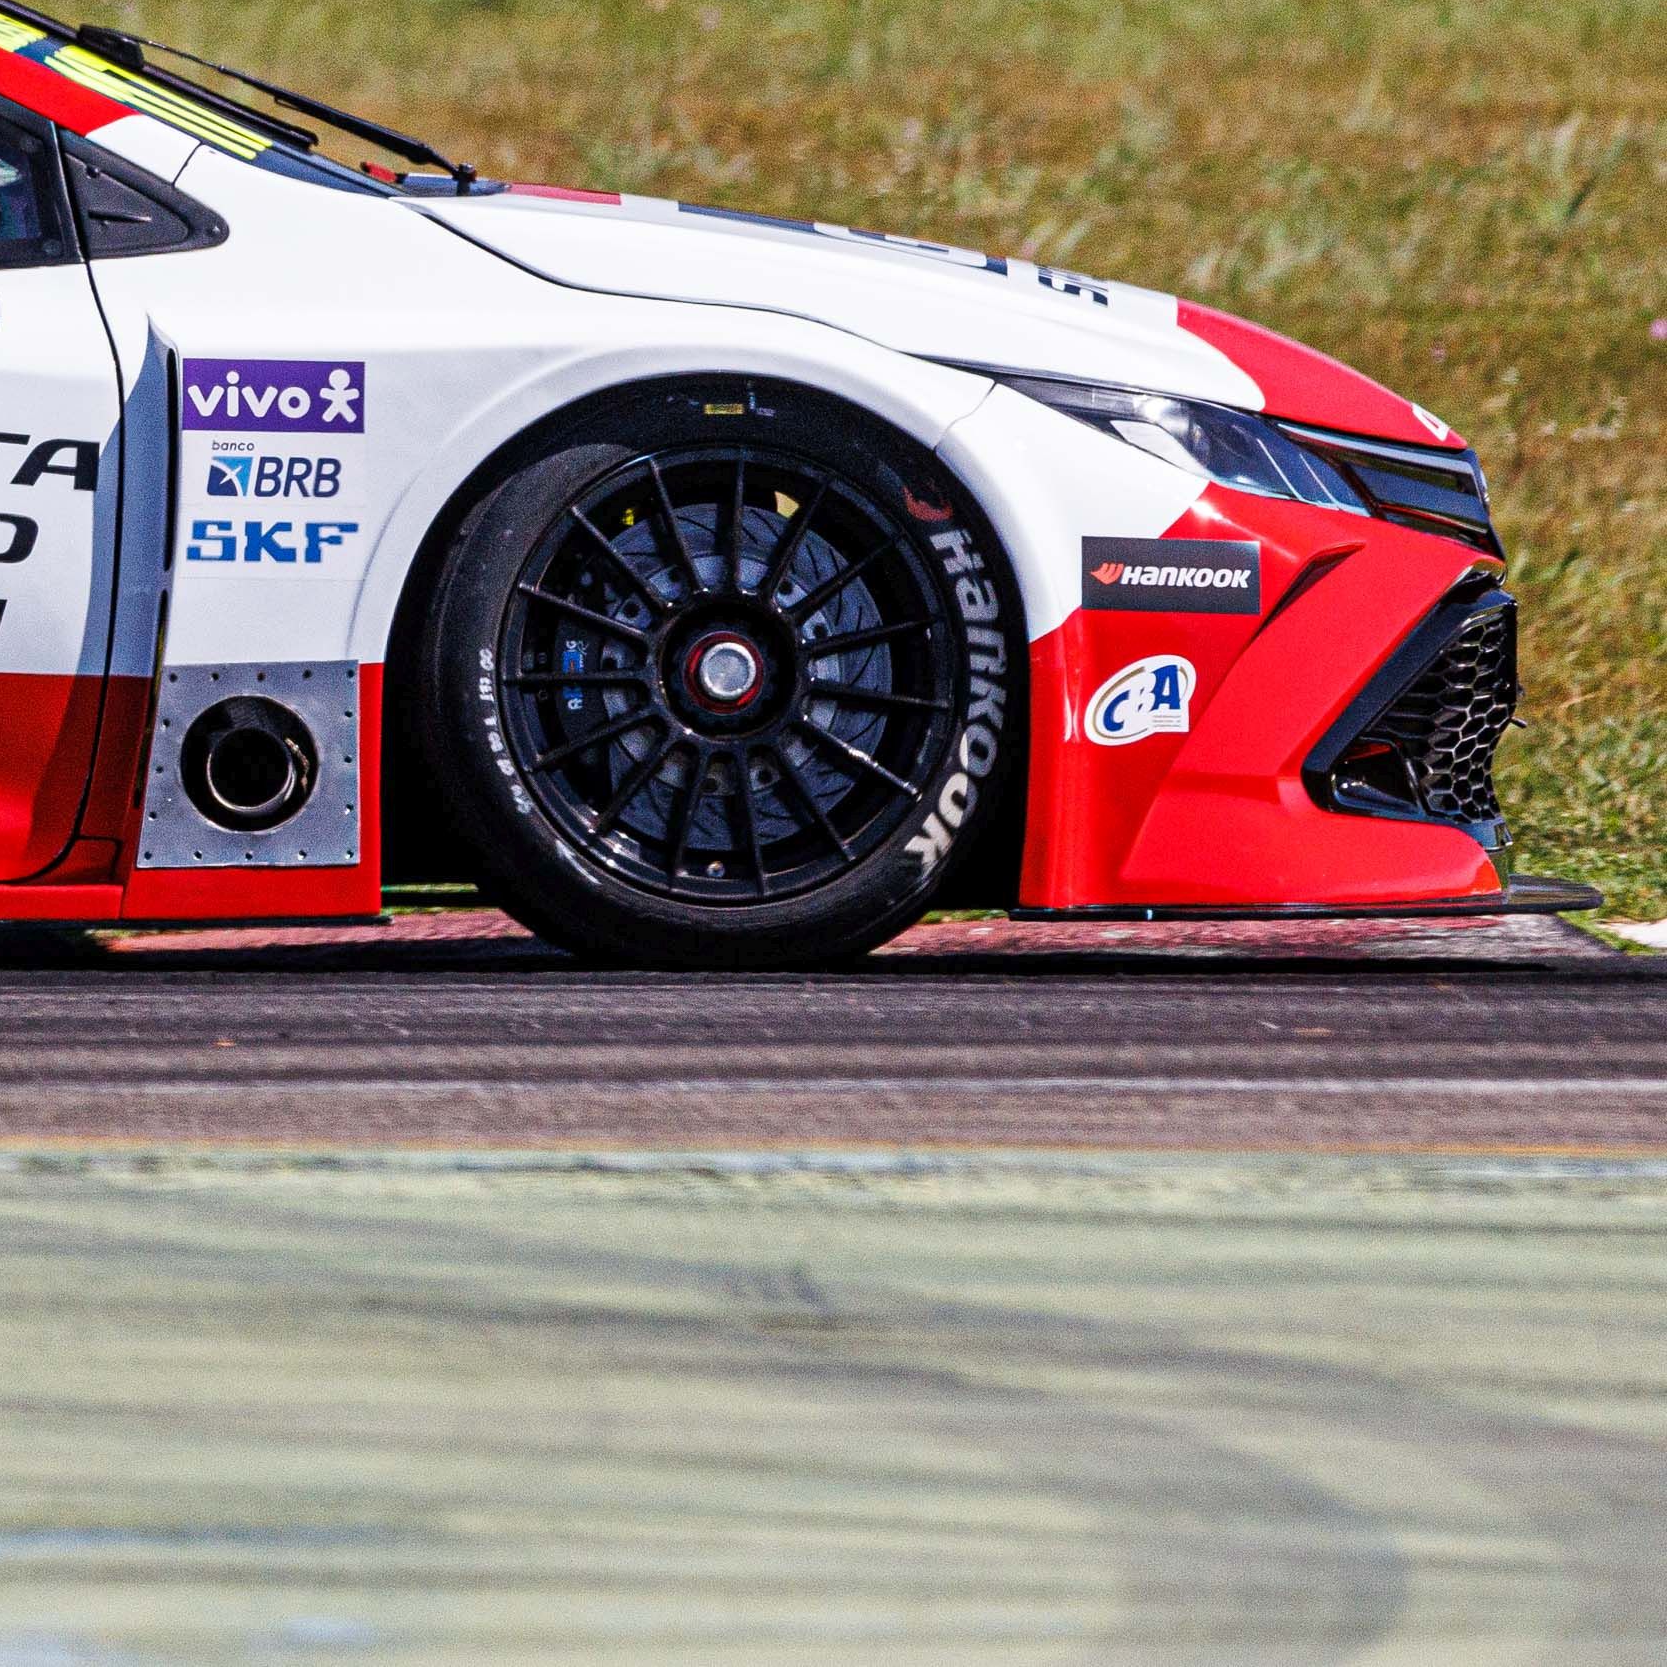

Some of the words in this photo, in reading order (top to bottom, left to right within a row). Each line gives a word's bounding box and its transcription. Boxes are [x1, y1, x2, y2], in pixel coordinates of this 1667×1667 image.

[188, 370, 311, 418] vivo
[211, 440, 256, 453] banco
[254, 456, 342, 498] BRB
[185, 520, 359, 563] SKF
[1102, 664, 1181, 732] CBA
